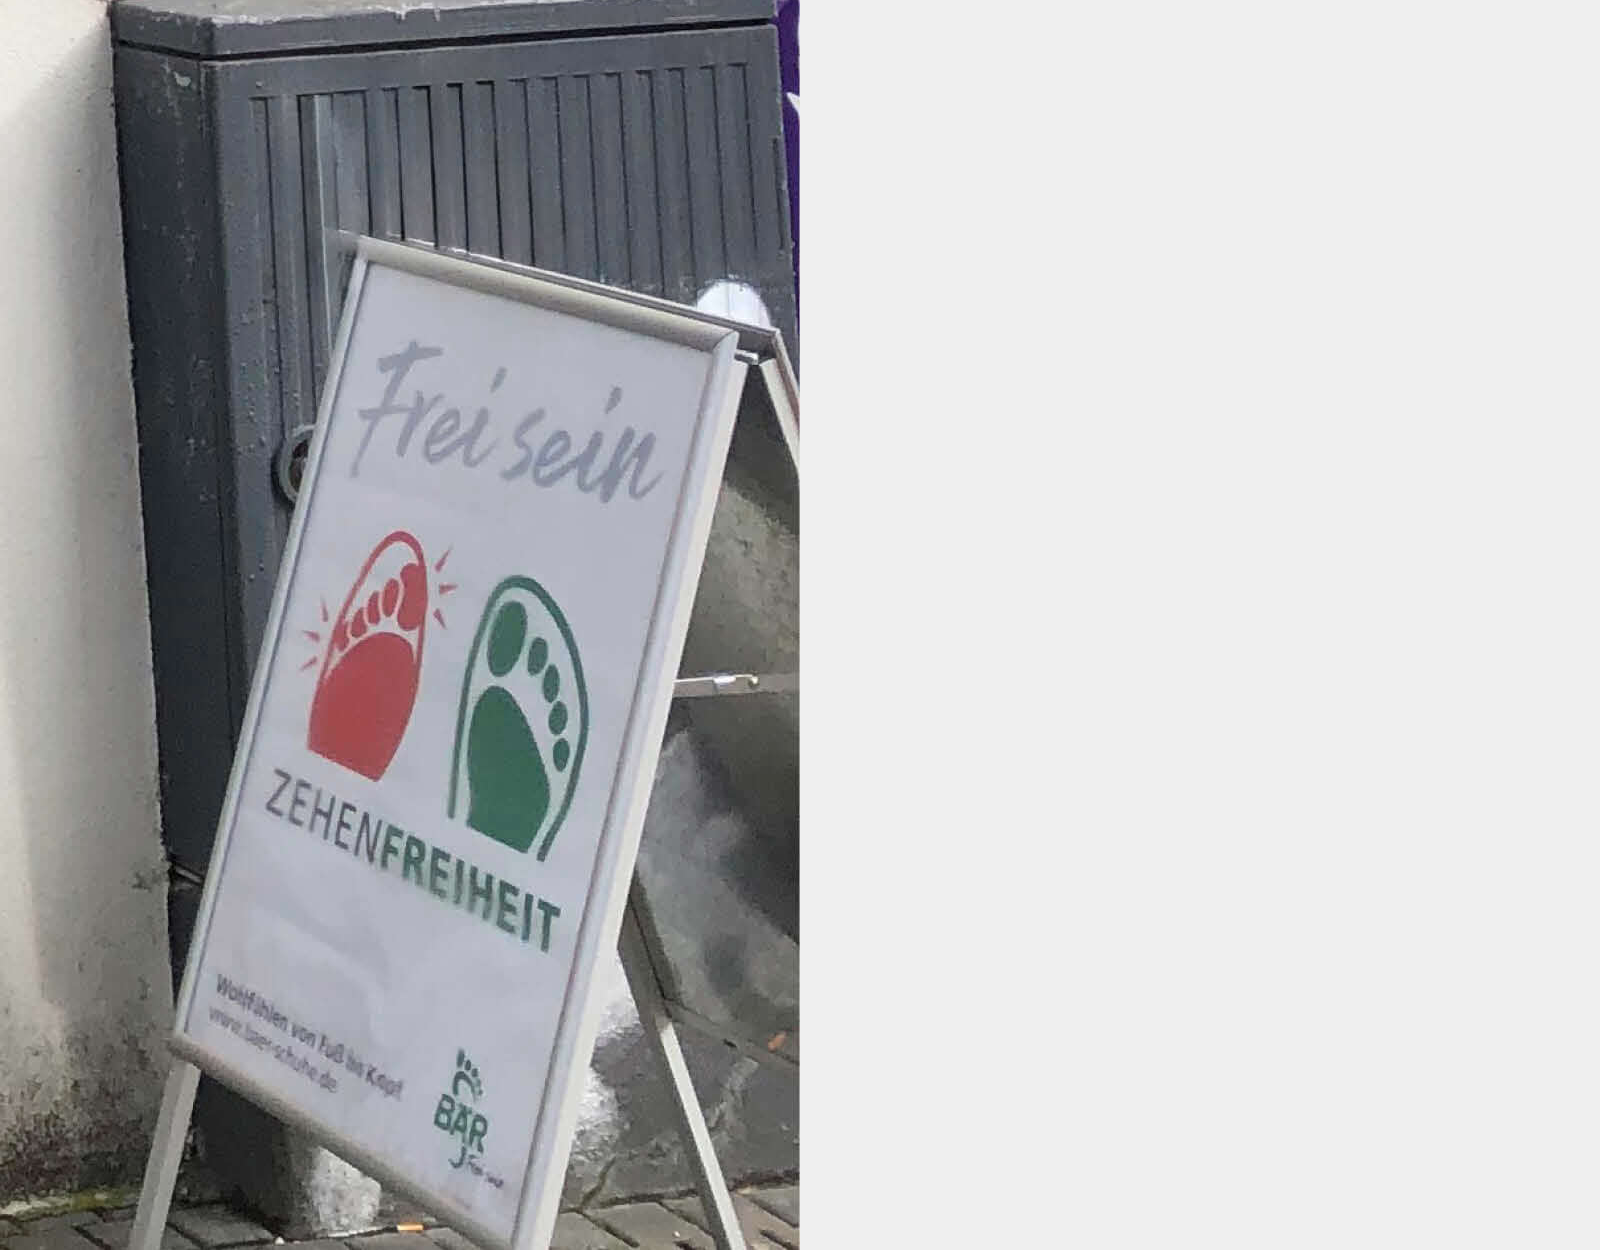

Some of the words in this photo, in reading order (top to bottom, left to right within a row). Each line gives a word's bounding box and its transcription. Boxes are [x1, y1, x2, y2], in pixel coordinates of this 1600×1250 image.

[349, 340, 506, 478] Frei
[502, 385, 664, 504] sein
[265, 768, 561, 954] ZEHENFREIHEIT
[216, 974, 288, 1032] Wohlfühlen
[291, 1021, 317, 1050] von
[318, 1034, 345, 1065] Fuß
[433, 1093, 488, 1154] BÄR
